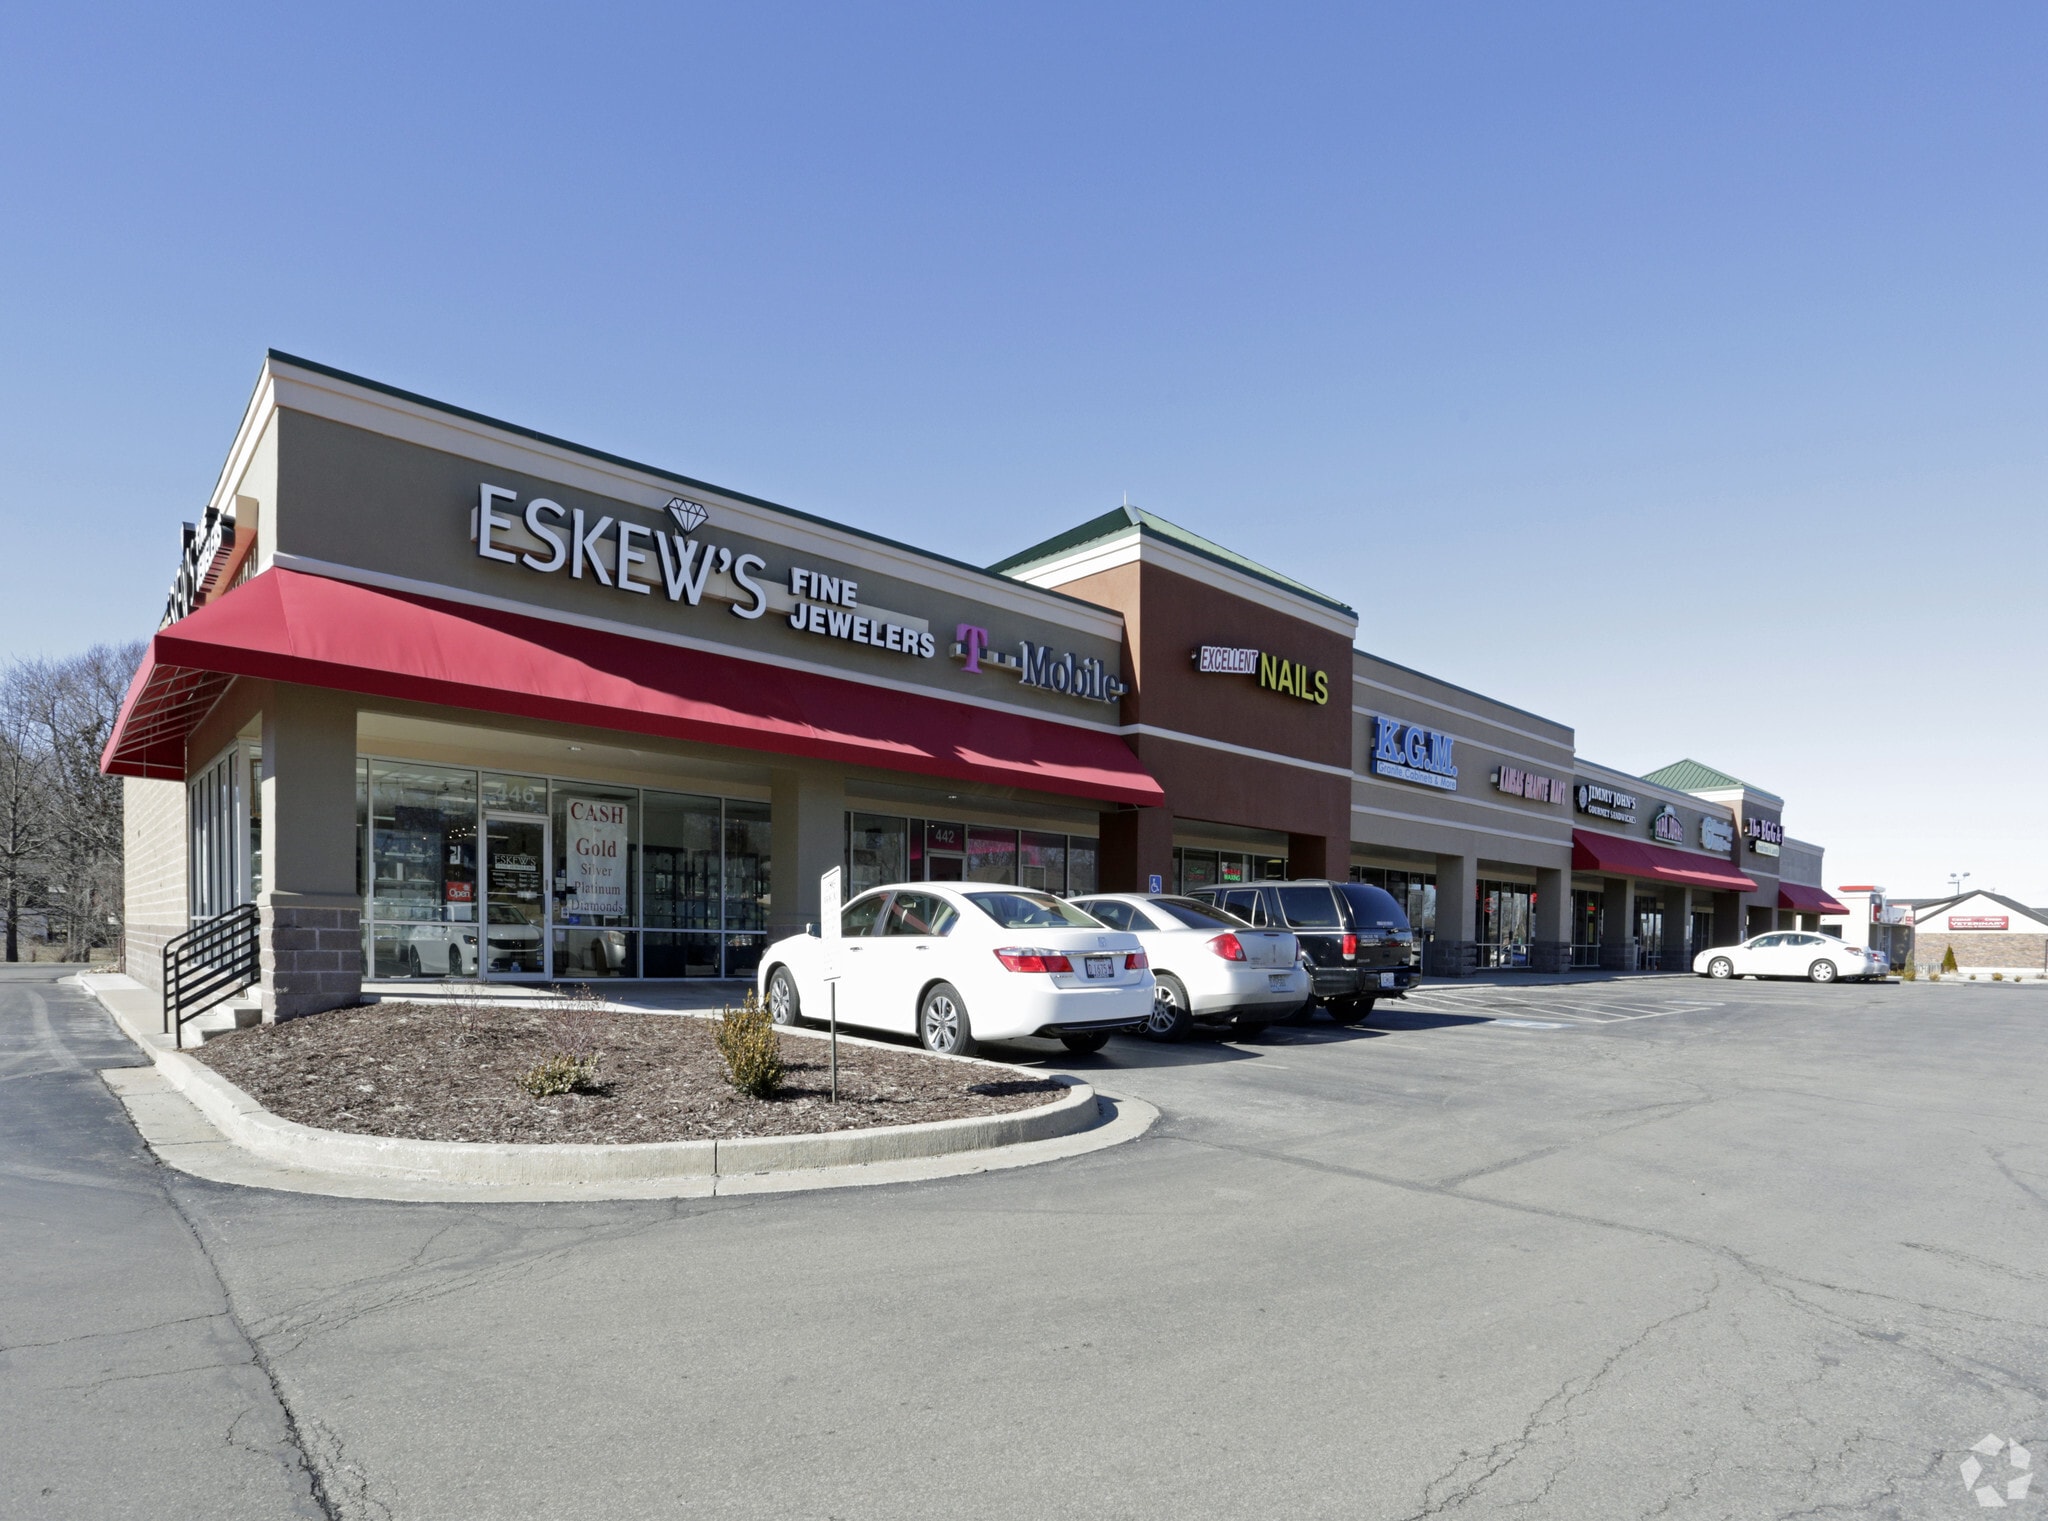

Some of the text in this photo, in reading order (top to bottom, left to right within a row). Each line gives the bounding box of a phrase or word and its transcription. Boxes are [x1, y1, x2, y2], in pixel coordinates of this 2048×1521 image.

[478, 483, 766, 619] ESKEW'S
[790, 567, 858, 608] FINE
[788, 603, 935, 659] JEWELERS
[1200, 646, 1328, 705] EXCELLENT NAILS
[1376, 716, 1458, 777] K.G.M.
[1440, 779, 1456, 789] More
[1500, 765, 1523, 797] KANSAS
[496, 784, 536, 803] 446
[1588, 785, 1636, 809] JIMMY JOHN'S
[570, 802, 624, 824] CASH
[1588, 805, 1637, 824] GOURMET SANDWICHES
[935, 829, 954, 844] 442
[1761, 820, 1776, 844] EGG
[576, 838, 617, 858] Gold
[494, 855, 536, 866] ESKEW'S
[581, 863, 613, 877] Silver
[449, 888, 471, 898] Open
[574, 881, 620, 896] Platinum
[571, 899, 623, 914] Diamonds
